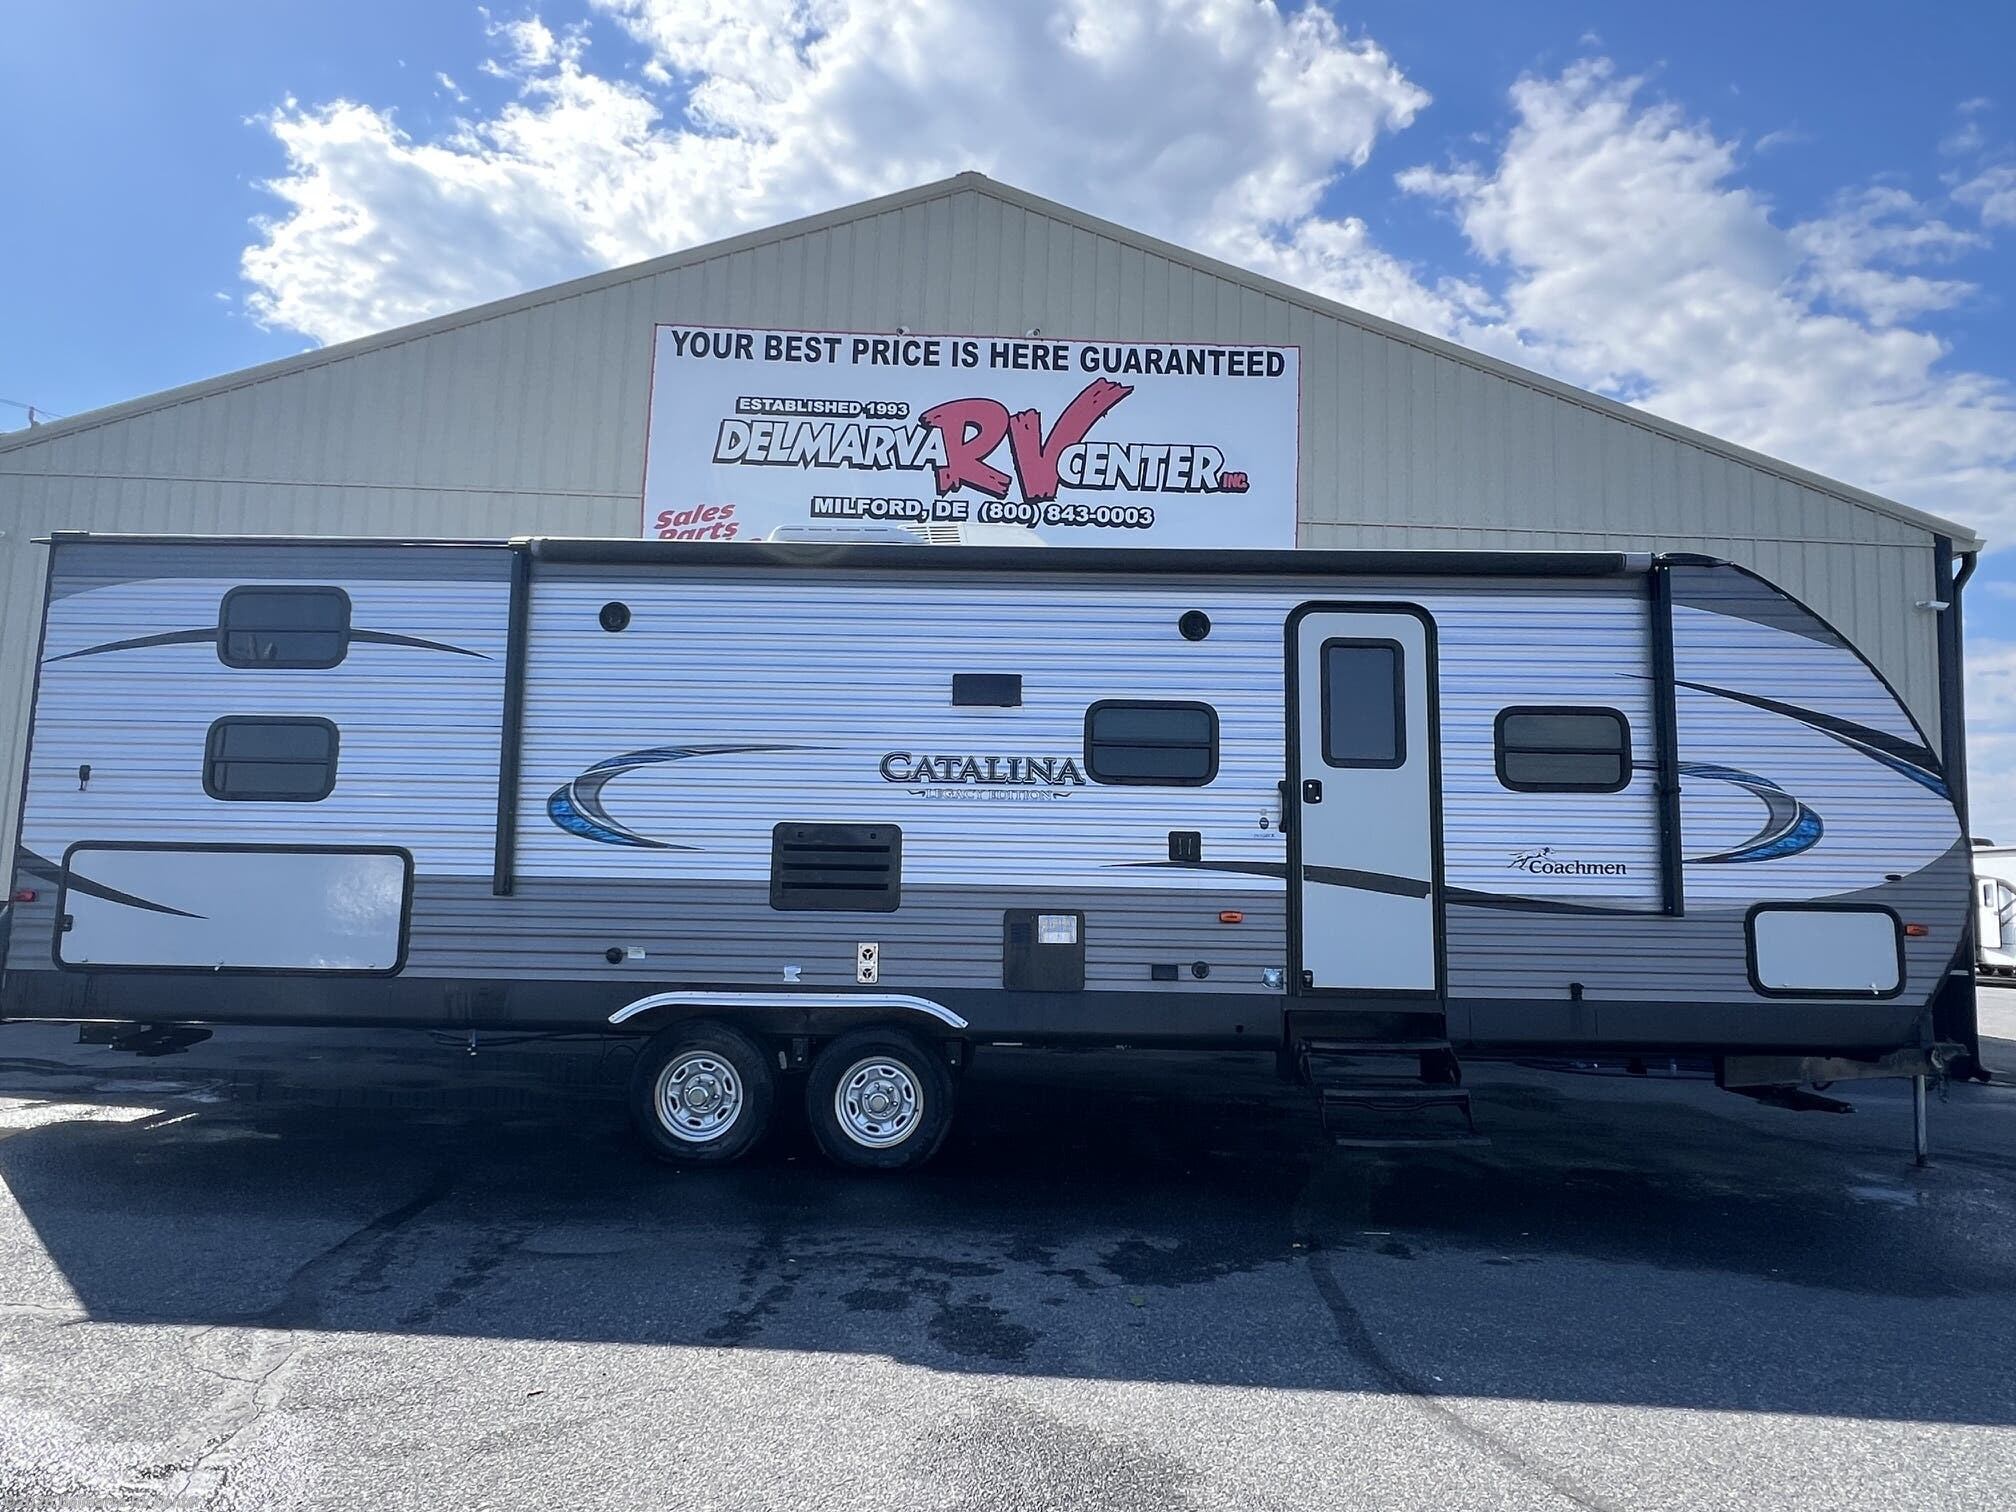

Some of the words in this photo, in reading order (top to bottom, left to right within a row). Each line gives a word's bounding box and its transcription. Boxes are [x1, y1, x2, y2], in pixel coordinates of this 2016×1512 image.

[671, 330, 754, 360] YOUR
[764, 334, 842, 363] BEST
[852, 339, 940, 367] PRICE
[951, 341, 979, 367] IS
[990, 342, 1070, 371] HERE
[1080, 346, 1286, 377] GUARANTEED
[737, 397, 862, 416] ESTABLISHED
[865, 402, 909, 418] 1993
[713, 419, 950, 470] DELMARVA
[920, 377, 1134, 503] RV
[1056, 442, 1225, 492] CENTER
[654, 504, 736, 529] Sales
[810, 497, 929, 520] MILFORD,
[933, 500, 969, 521] DE
[979, 502, 1041, 528] (800)
[1046, 504, 1154, 527] 843-0003
[658, 521, 739, 540] Parts
[879, 751, 1086, 784] CATALINA
[1529, 860, 1627, 875] Coachmen
